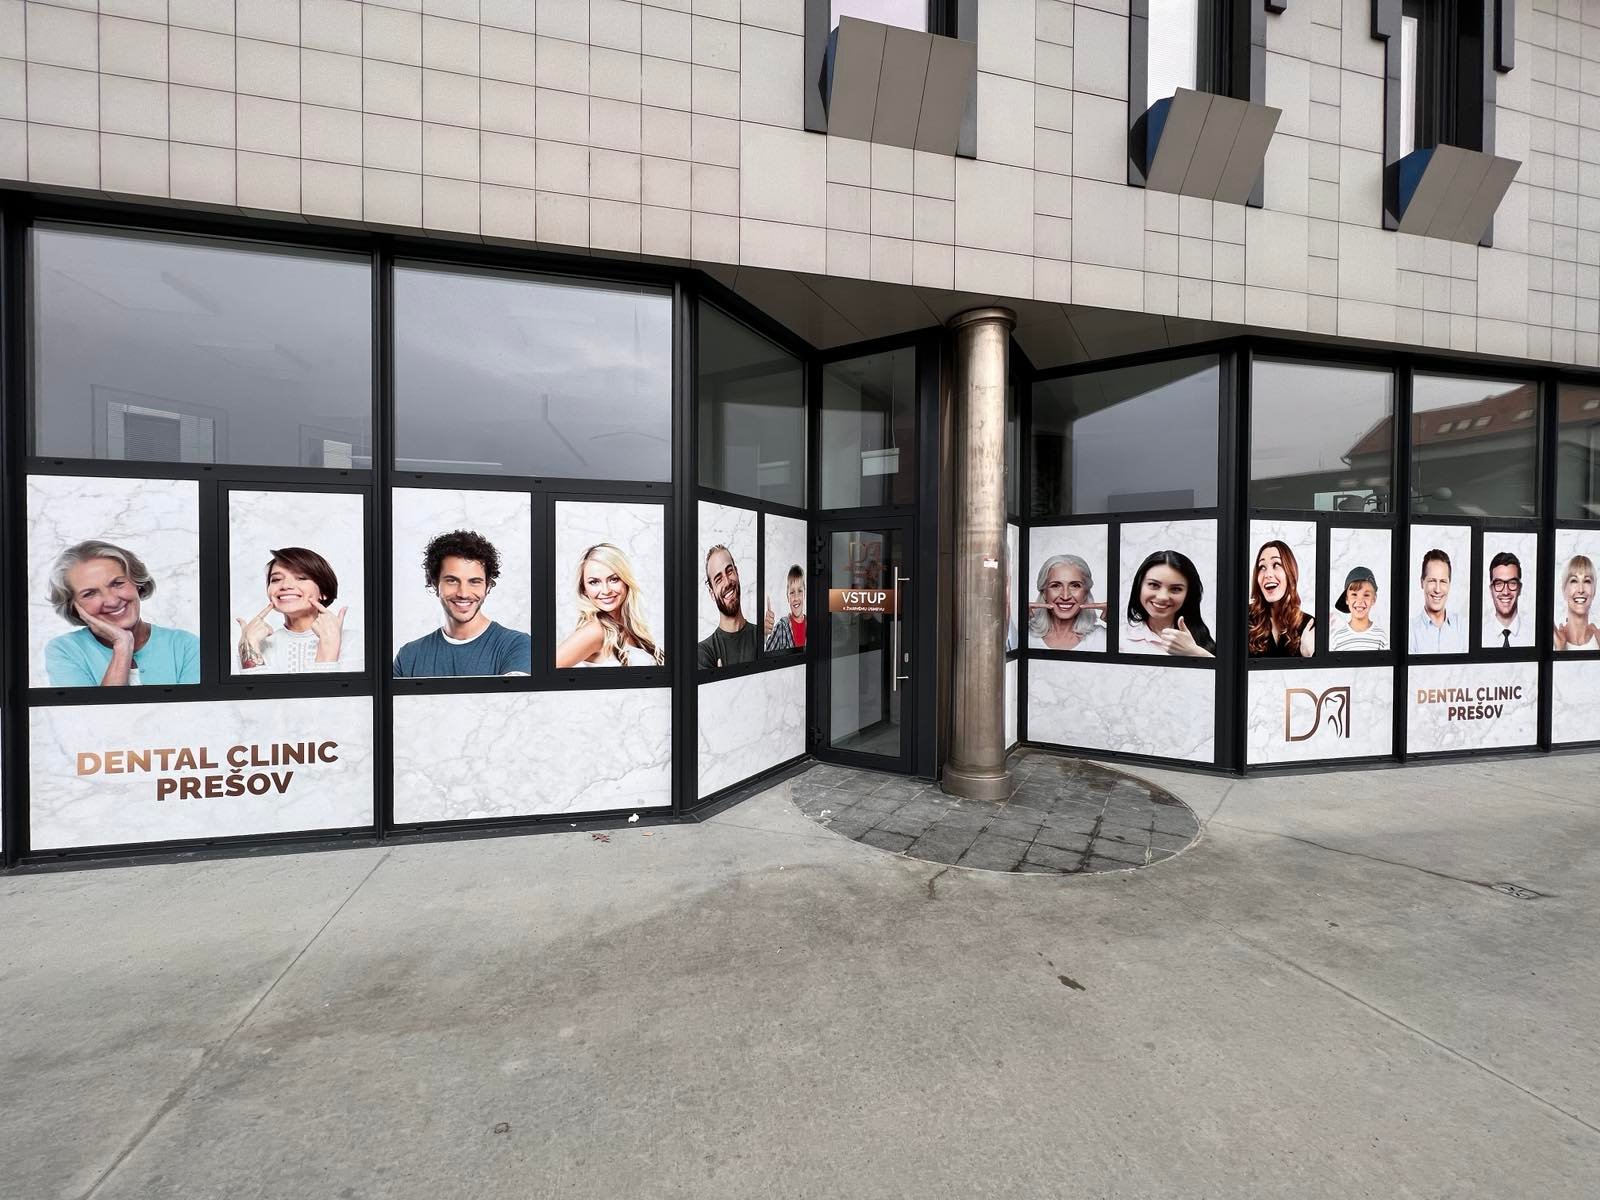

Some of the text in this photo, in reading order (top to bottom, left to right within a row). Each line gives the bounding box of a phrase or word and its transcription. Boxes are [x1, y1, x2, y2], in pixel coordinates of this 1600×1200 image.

[841, 591, 886, 604] VSTUP
[1417, 686, 1522, 704] DENTAL CLINIC
[1448, 702, 1503, 721] PREŠOV
[77, 741, 339, 776] DENTAL CLINIC
[157, 769, 294, 801] PREŠOV
